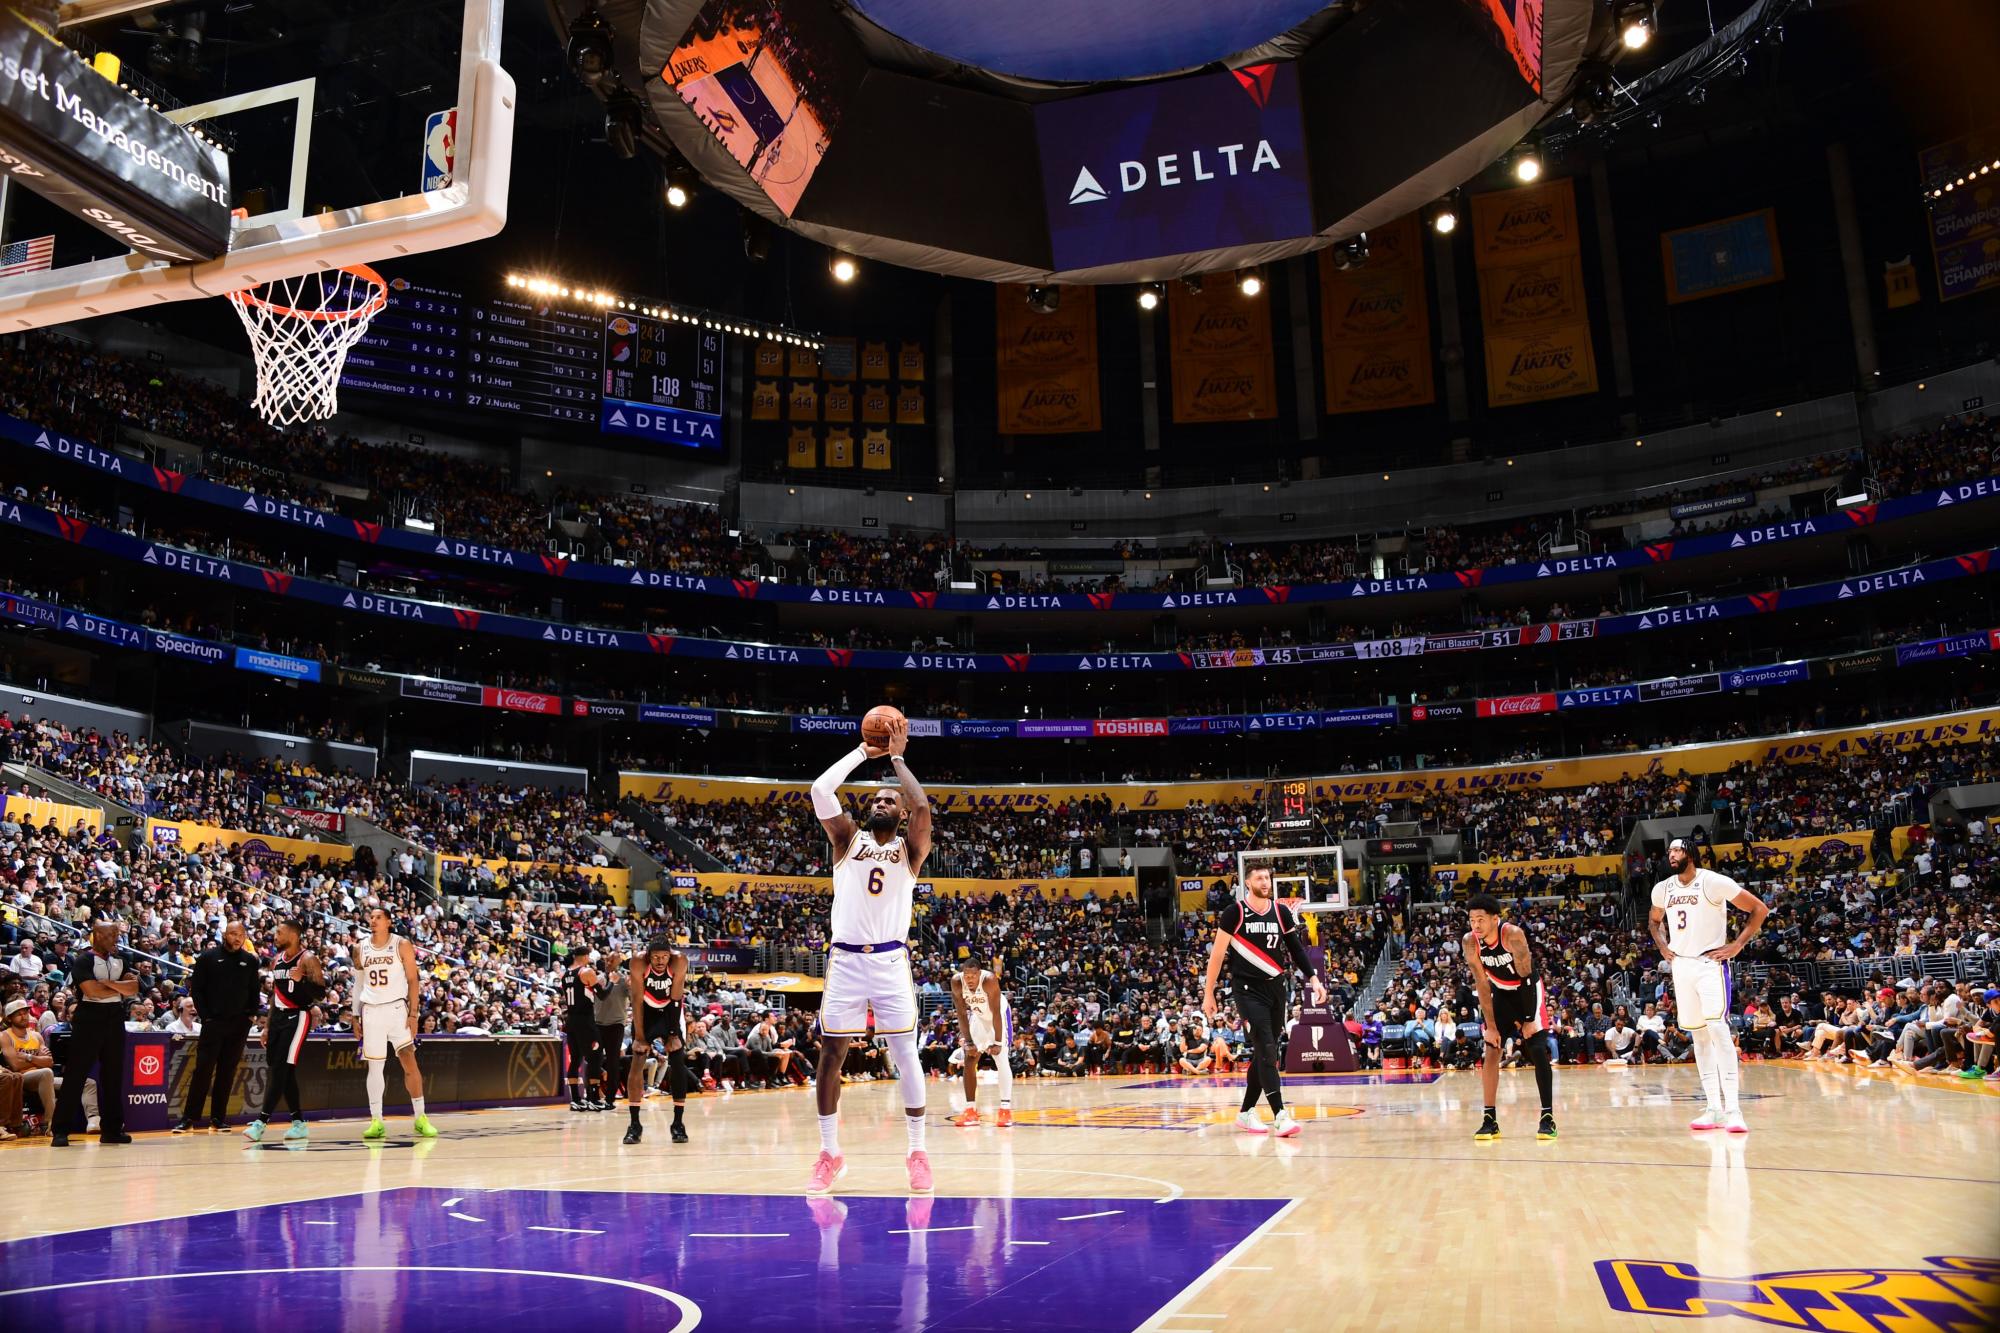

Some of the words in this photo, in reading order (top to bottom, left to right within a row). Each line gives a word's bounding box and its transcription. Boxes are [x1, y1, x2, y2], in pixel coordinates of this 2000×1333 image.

[55, 82, 228, 208] Management
[1120, 139, 1281, 193] DELTA
[1498, 208, 1552, 230] LAKERS
[1505, 280, 1561, 304] LAKERS
[477, 310, 483, 320] 0
[491, 314, 526, 327] D.Lillard
[411, 322, 421, 330] 10
[450, 328, 457, 336] 2
[476, 331, 481, 340] 1
[489, 335, 530, 348] A.Simons
[655, 328, 665, 343] 21
[703, 336, 716, 352] 45
[474, 353, 481, 362] 9
[488, 356, 519, 368] J.Grant
[656, 351, 666, 366] 19
[704, 359, 714, 374] 51
[1509, 350, 1574, 376] LAKERS
[470, 374, 482, 384] 11
[487, 377, 513, 388] J.Hart
[651, 375, 679, 397] 1:08
[468, 395, 482, 405] 27
[486, 398, 521, 410] J.Nurkic
[636, 413, 715, 439] DELTA
[58, 438, 122, 474] DELTA
[868, 443, 885, 456] 24
[265, 501, 325, 529] DELTA
[1677, 501, 1712, 515] AMERICAN
[1751, 521, 1816, 543] DELTA
[455, 543, 514, 566] DELTA
[164, 552, 231, 579] DELTA
[1556, 556, 1617, 574] DELTA
[650, 573, 706, 591] DELTA
[1370, 578, 1428, 594] DELTA
[1858, 569, 1925, 593] DELTA
[829, 590, 885, 604] DELTA
[1005, 596, 1061, 608] DELTA
[1180, 592, 1237, 606] DELTA
[16, 604, 56, 623] ULTRA
[362, 596, 424, 619] DELTA
[1658, 605, 1720, 626] DELTA
[84, 619, 140, 645] DELTA
[561, 628, 619, 647] DELTA
[1492, 632, 1510, 646] 51
[1566, 629, 1572, 638] 5
[1583, 628, 1590, 637] 5
[156, 635, 223, 660] Spectrum
[1364, 641, 1402, 657] 1:08
[1414, 643, 1422, 654] 2
[1428, 639, 1446, 651] Trail
[1448, 638, 1480, 648] Blazers
[1946, 637, 1986, 654] ULTRA
[743, 647, 799, 662] DELTA
[1200, 658, 1206, 667] 5
[1215, 657, 1222, 666] 4
[1272, 650, 1292, 664] 45
[1312, 649, 1345, 659] Lakers
[249, 654, 309, 673] mobilitie
[922, 656, 977, 669] DELTA
[1097, 657, 1152, 669] DELTA
[1745, 667, 1799, 683] crypto.com
[426, 681, 442, 690] High
[444, 684, 467, 693] School
[1661, 681, 1678, 689] High
[1680, 678, 1703, 686] School
[424, 689, 457, 700] Exchange
[1579, 689, 1634, 704] DELTA
[1661, 687, 1694, 696] Exchange
[505, 693, 549, 711] Coca-Cola
[1499, 698, 1542, 713] Coca-Cola
[591, 705, 625, 717] TOYOTA
[644, 711, 679, 720] AMERICAN
[680, 713, 712, 722] EXPRESS
[1325, 714, 1360, 724] AMERICAN
[1362, 712, 1393, 722] EXPRESS
[1429, 706, 1463, 717] TOYOTA
[800, 717, 857, 733] Spectrum
[963, 723, 1010, 736] crypto.com
[1097, 722, 1164, 734] TOSHIBA
[1209, 720, 1241, 730] ULTRA
[1265, 715, 1316, 729] DELTA
[1766, 742, 1823, 760] LOS
[1832, 722, 1968, 752] ANGELES
[1284, 782, 1306, 795] 1:08
[1314, 779, 1430, 798] ANGELES
[1435, 770, 1544, 792] LAKERS
[945, 792, 1051, 807] LAKERS
[1284, 797, 1304, 816] 14
[1281, 820, 1311, 828] TISSOT
[156, 828, 177, 841] 103
[852, 844, 900, 865] LAKERS
[676, 878, 695, 887] 105
[868, 867, 885, 895] 6
[1438, 871, 1455, 880] 107
[1181, 880, 1201, 890] 106
[1667, 895, 1699, 908] LAKERS
[1245, 921, 1279, 934] PORTLAND
[1677, 910, 1687, 930] 3
[1266, 934, 1279, 949] 27
[364, 956, 393, 967] LAKERS
[708, 953, 737, 962] ULTRA
[1506, 963, 1515, 974] 1
[370, 969, 388, 986] 95
[288, 980, 294, 993] 0
[566, 986, 575, 1006] 11
[128, 1093, 167, 1105] TOYOTA
